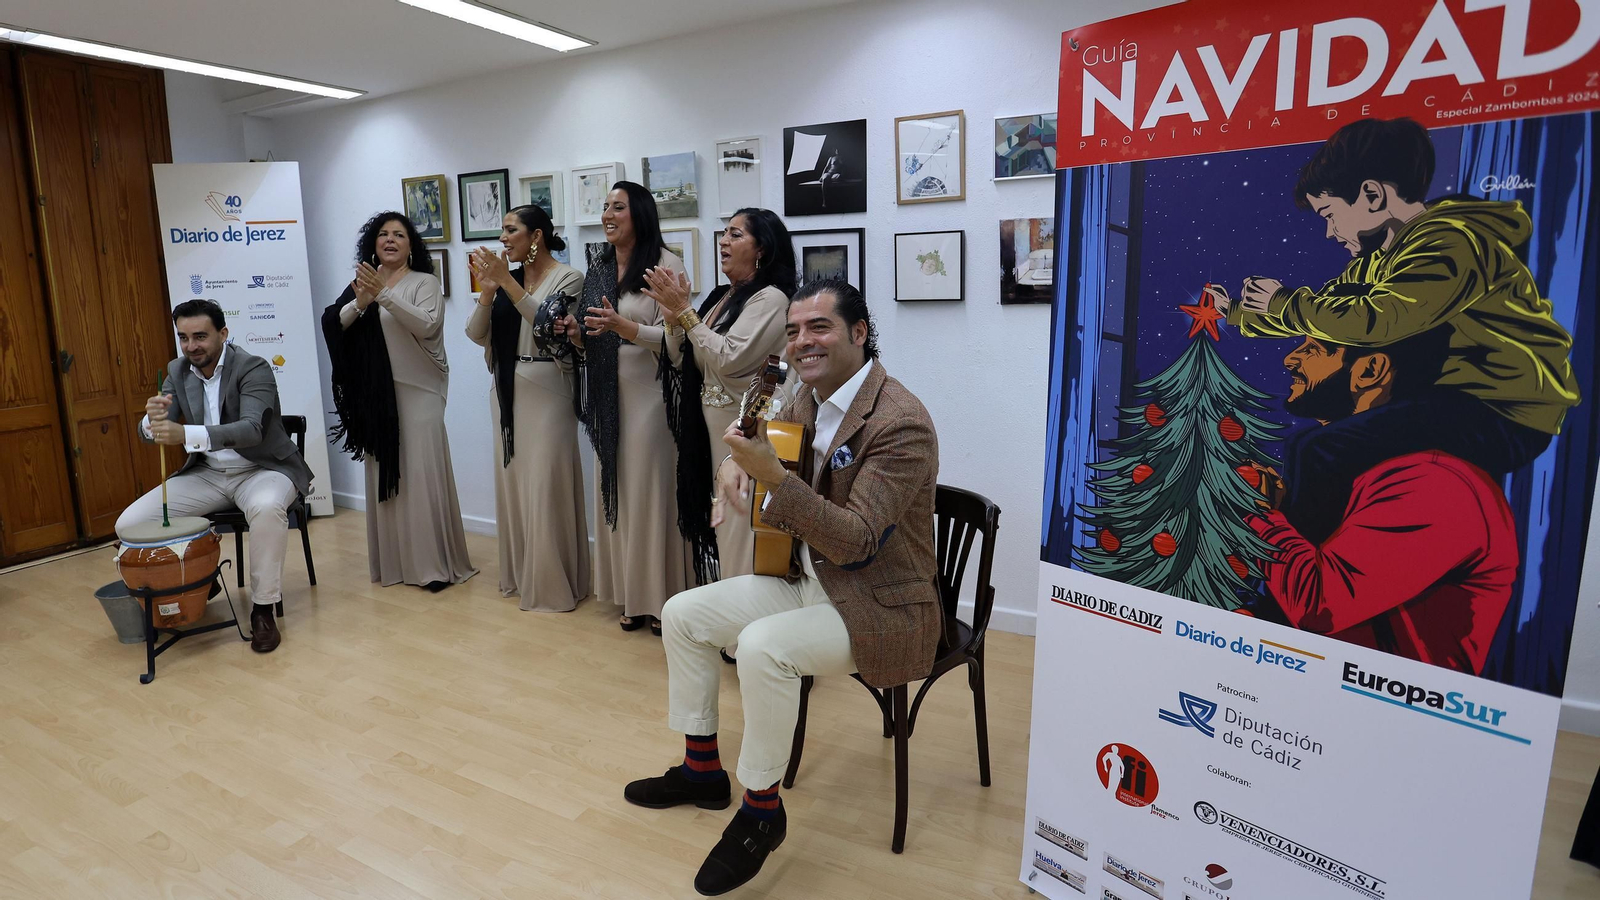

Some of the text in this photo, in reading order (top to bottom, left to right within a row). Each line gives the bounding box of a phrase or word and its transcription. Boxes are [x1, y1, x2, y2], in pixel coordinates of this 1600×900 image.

[1082, 38, 1138, 67] Guía
[1081, 0, 1600, 137] NAVIDAD
[1079, 72, 1599, 150] PROVINCIA DE CÁDIZ
[1436, 90, 1600, 119] Especial Zambombas 2024
[224, 195, 242, 207] 40
[170, 225, 286, 246] Diario de Jerez
[1051, 584, 1163, 630] DIARIO DE CADIZ
[1175, 620, 1307, 673] Diario de Jerez
[1216, 682, 1259, 703] Patrocina:
[1341, 661, 1507, 727] EuropaSur
[1224, 706, 1323, 755] Diputación
[1222, 730, 1302, 771] de Cádiz
[1206, 764, 1252, 788] Colaboran:
[1151, 803, 1180, 821] flamenco
[1038, 820, 1085, 850] DIARIO DE CADIZ
[1035, 850, 1062, 870] Huelva
[1219, 813, 1385, 896] VENENCIADORES, S.L.
[1221, 827, 1251, 844] EMPRESA
[1251, 840, 1261, 849] DE
[1261, 846, 1282, 858] JEREZ
[1293, 859, 1341, 884] CERTIFICADO
[1106, 856, 1157, 888] Diario de Jerez
[1183, 876, 1224, 900] GRUPO
